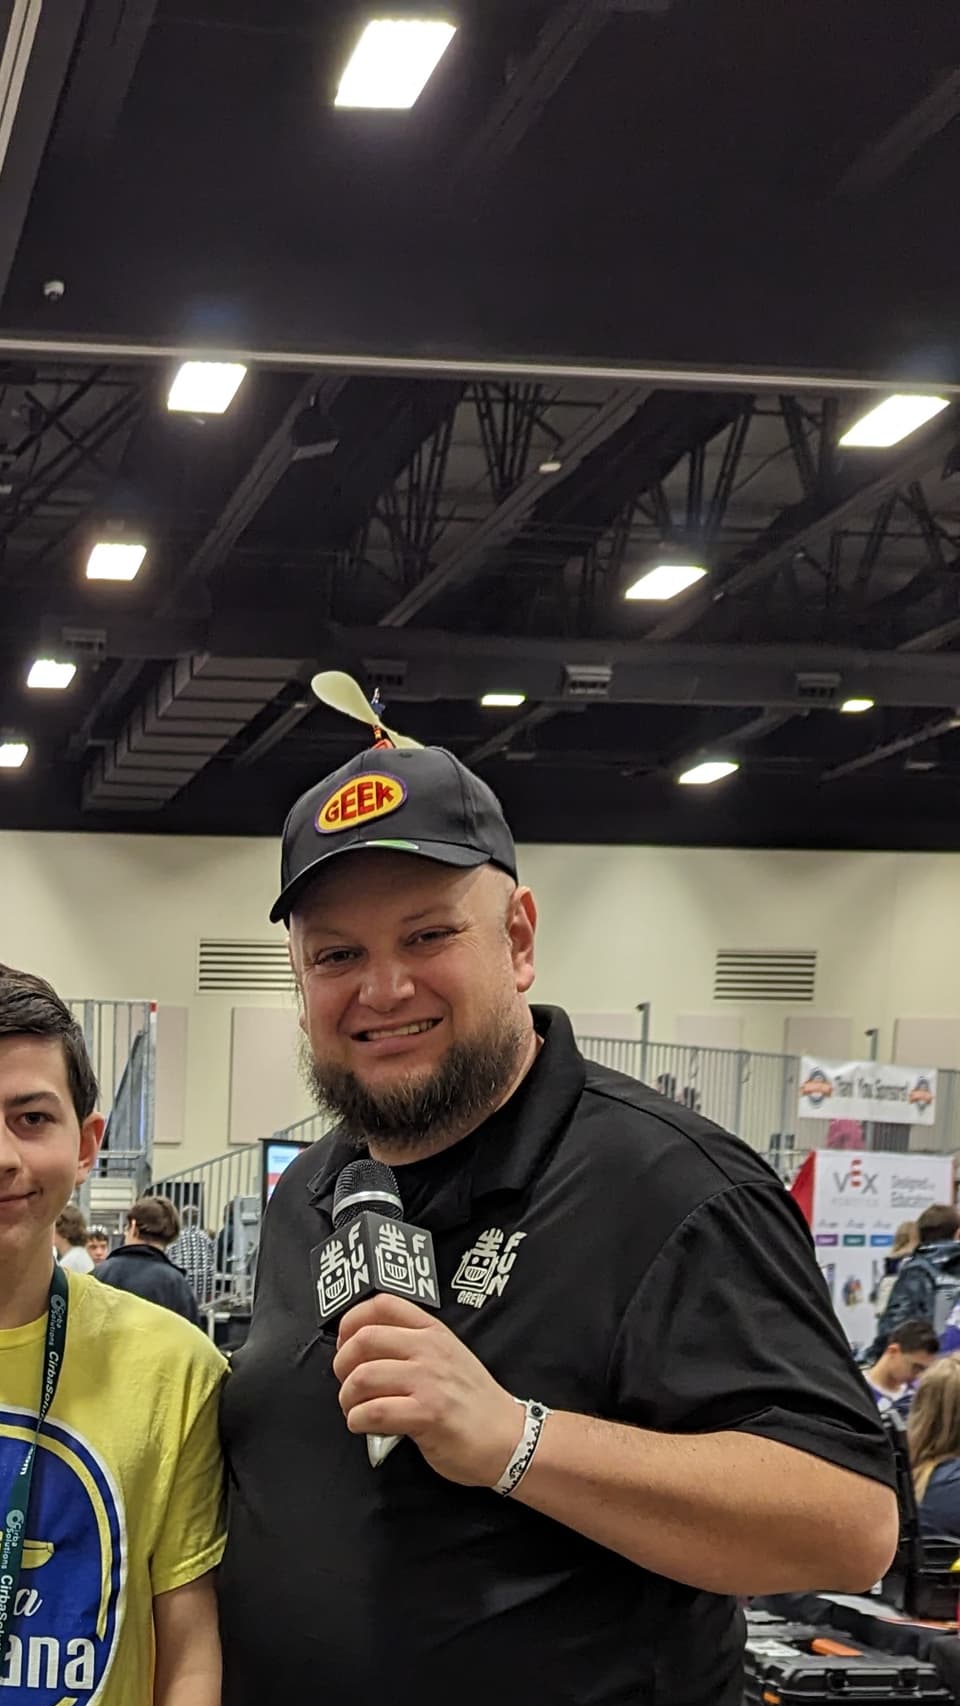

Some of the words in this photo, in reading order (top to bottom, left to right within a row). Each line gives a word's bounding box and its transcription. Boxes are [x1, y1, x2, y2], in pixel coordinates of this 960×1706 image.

[324, 780, 395, 823] GEEK
[833, 1158, 879, 1195] VEX
[347, 1221, 370, 1295] FUN
[411, 1233, 437, 1301] FUN
[485, 1231, 528, 1297] FUN
[457, 1290, 488, 1309] CREW
[1, 1527, 12, 1569] Solutions
